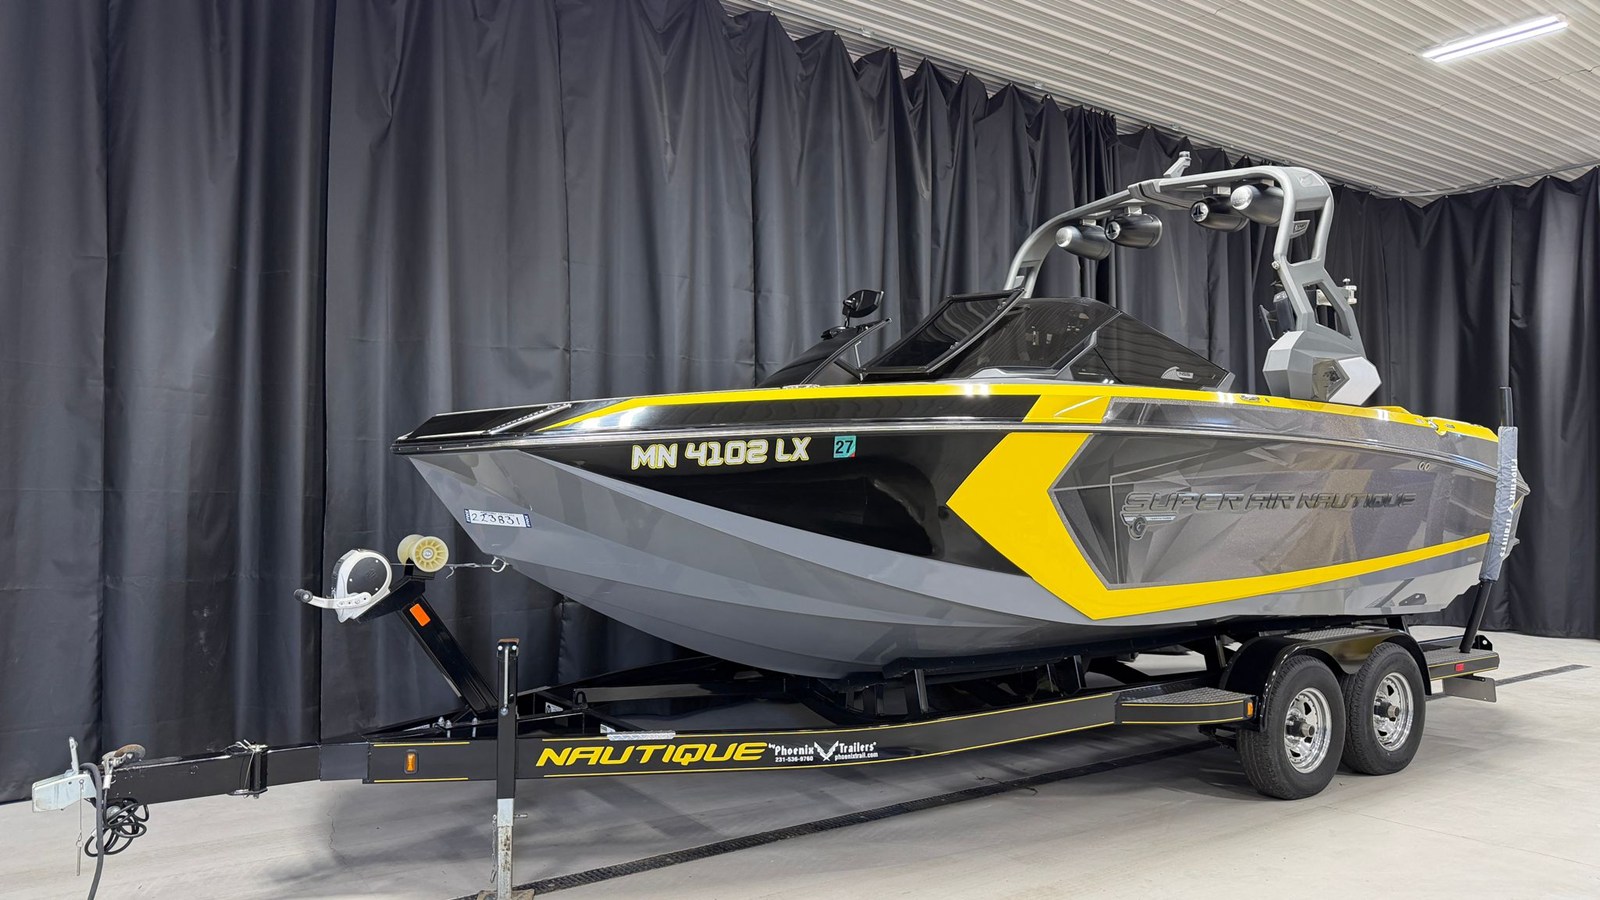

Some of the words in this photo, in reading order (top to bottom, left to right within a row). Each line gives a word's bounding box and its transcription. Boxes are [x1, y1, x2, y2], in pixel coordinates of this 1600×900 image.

[631, 443, 678, 470] MN
[685, 439, 769, 467] 4102
[775, 437, 812, 463] LX
[835, 440, 854, 454] 27
[1122, 492, 1245, 512] SUPER
[1246, 492, 1295, 510] AIR
[1297, 493, 1416, 510] NAUTIQUE
[535, 742, 767, 767] NAUTIQUE
[774, 745, 814, 756] Phoenix
[834, 752, 879, 761] phoenixtrail.com
